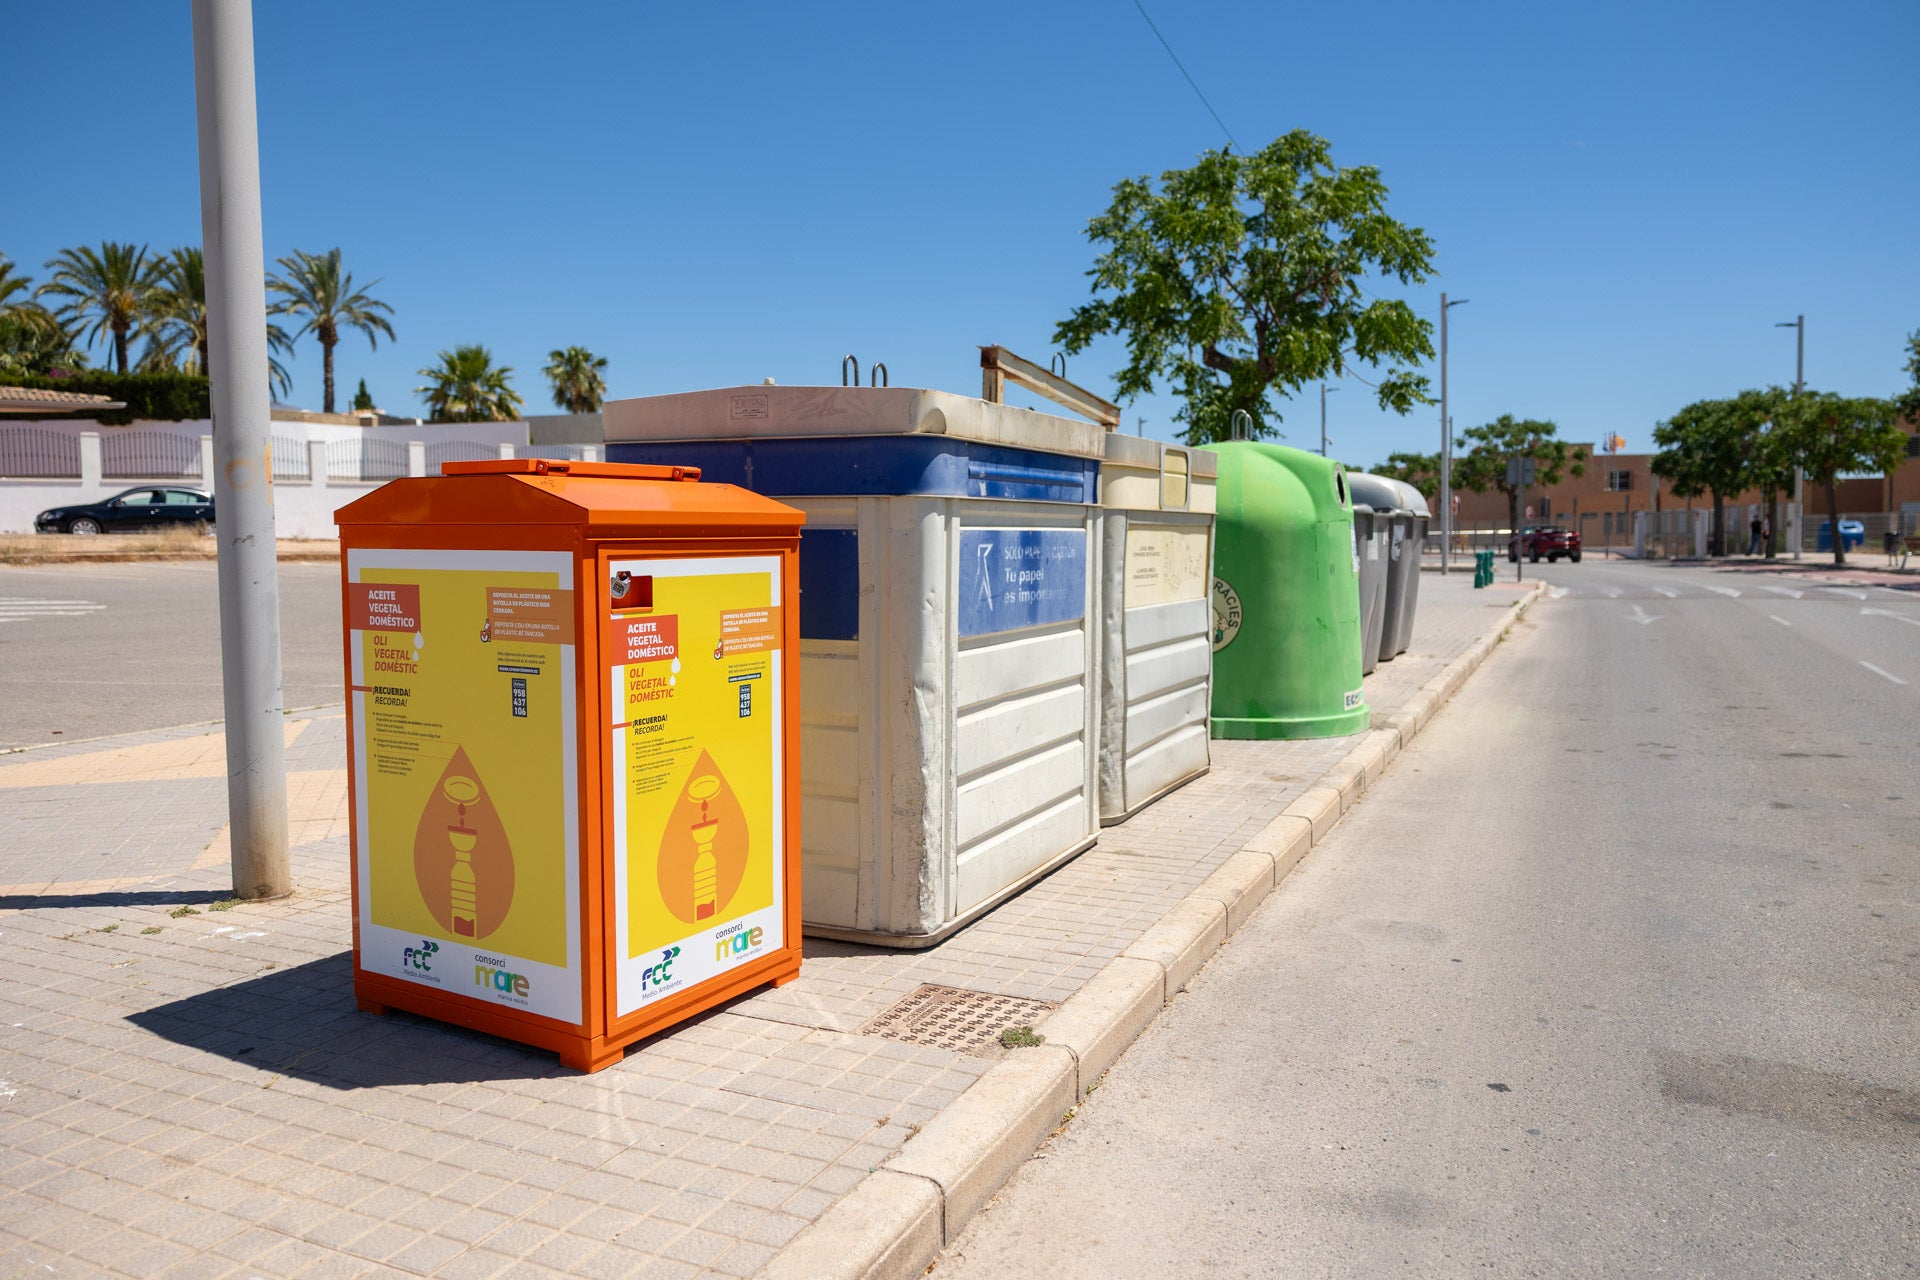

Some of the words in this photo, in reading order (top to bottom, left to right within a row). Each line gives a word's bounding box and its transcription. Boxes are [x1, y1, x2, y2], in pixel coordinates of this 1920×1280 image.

[1004, 567, 1017, 583] Tu
[1019, 568, 1044, 585] papel
[368, 590, 396, 601] ACEITE
[1004, 591, 1016, 604] es
[369, 603, 402, 614] VEGETAL
[369, 614, 415, 628] DOMÉSTICO
[628, 622, 657, 634] ACEITE
[373, 635, 388, 646] OLI
[628, 634, 663, 646] VEGETAL
[374, 648, 410, 660] VEGETAL
[628, 645, 675, 660] DOMÉSTICO
[629, 667, 644, 678] OLI
[630, 677, 667, 691] VEGETAL
[372, 686, 411, 697] ¡RECUERDA!
[513, 689, 526, 697] 958
[375, 696, 408, 707] RECORDA!
[513, 698, 526, 706] 437
[514, 707, 527, 716] 106
[632, 714, 668, 728] ¡RECUERDA!
[634, 723, 665, 735] RECORDA!
[715, 921, 743, 939] consorci
[715, 926, 763, 962] mare
[475, 954, 506, 968] consorci
[475, 965, 530, 998] mare
[642, 990, 657, 1001] Medio
[658, 979, 682, 993] Ambiente
